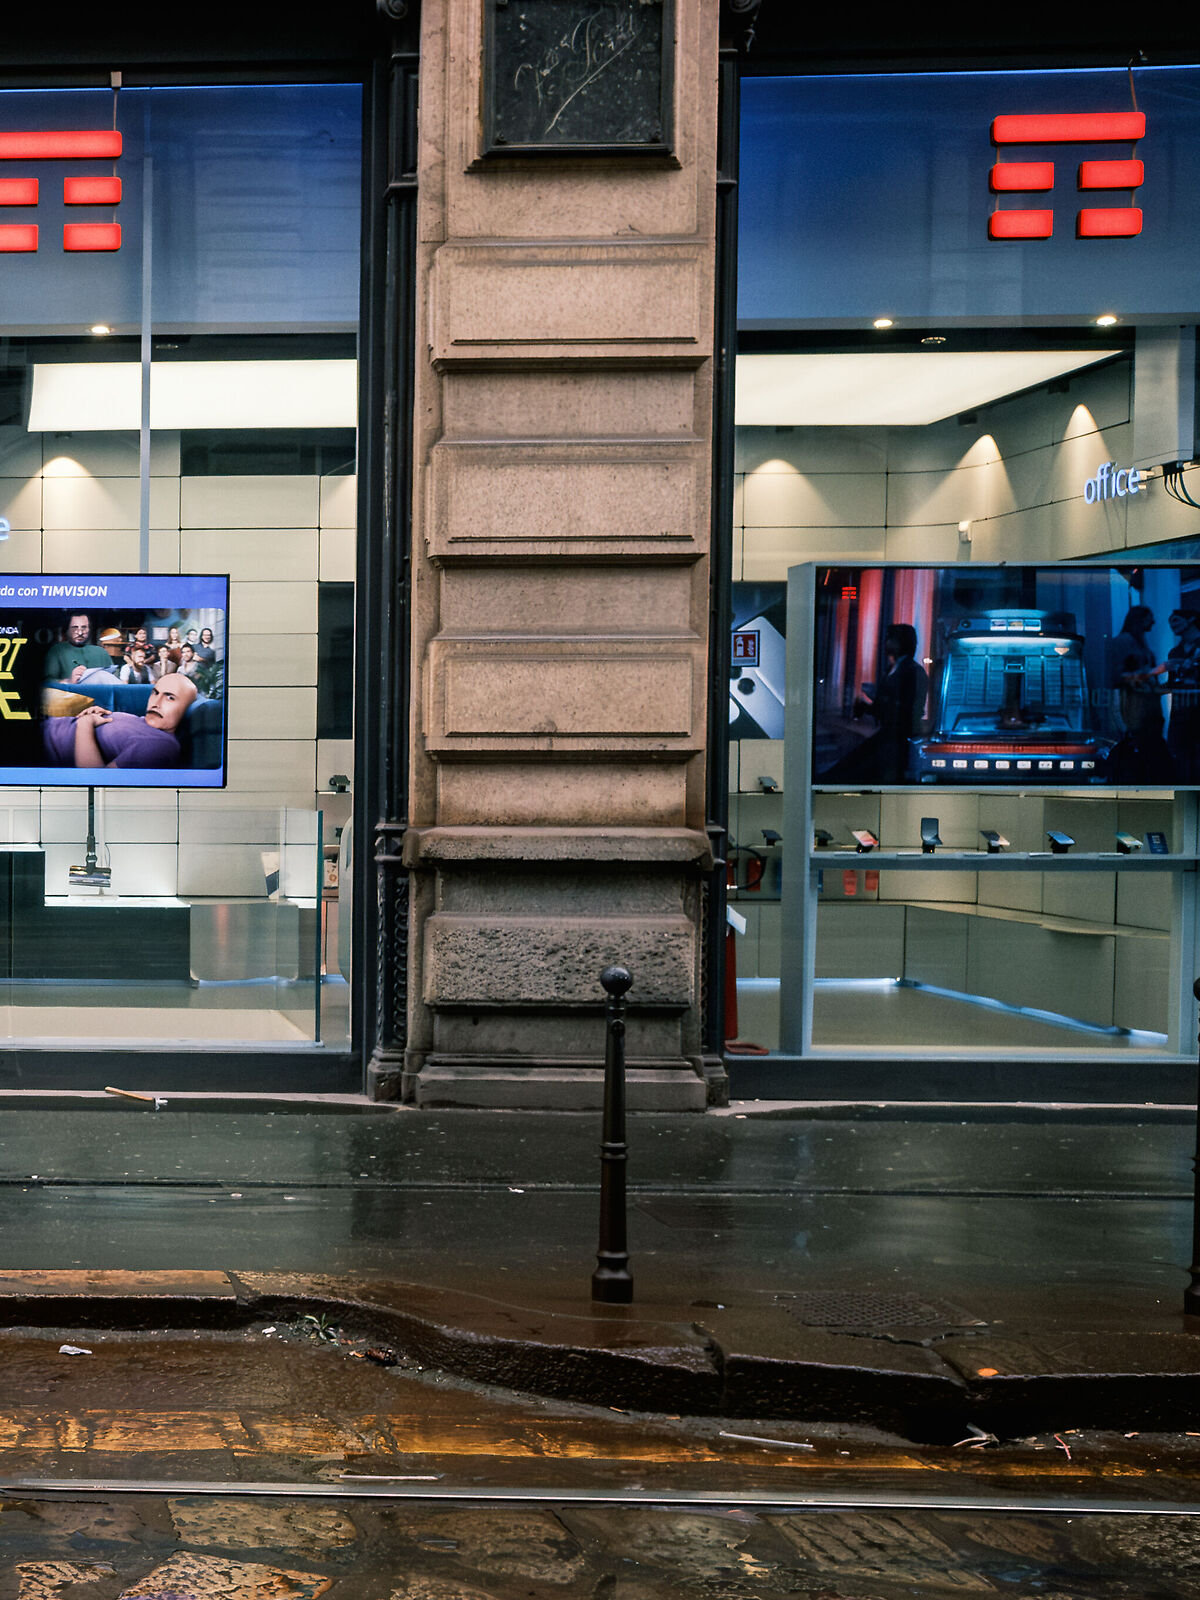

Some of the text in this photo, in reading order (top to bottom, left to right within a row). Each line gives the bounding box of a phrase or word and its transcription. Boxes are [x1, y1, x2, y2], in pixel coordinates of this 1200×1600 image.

[1083, 461, 1141, 504] office
[17, 587, 39, 597] con
[41, 585, 108, 597] TIMVISION
